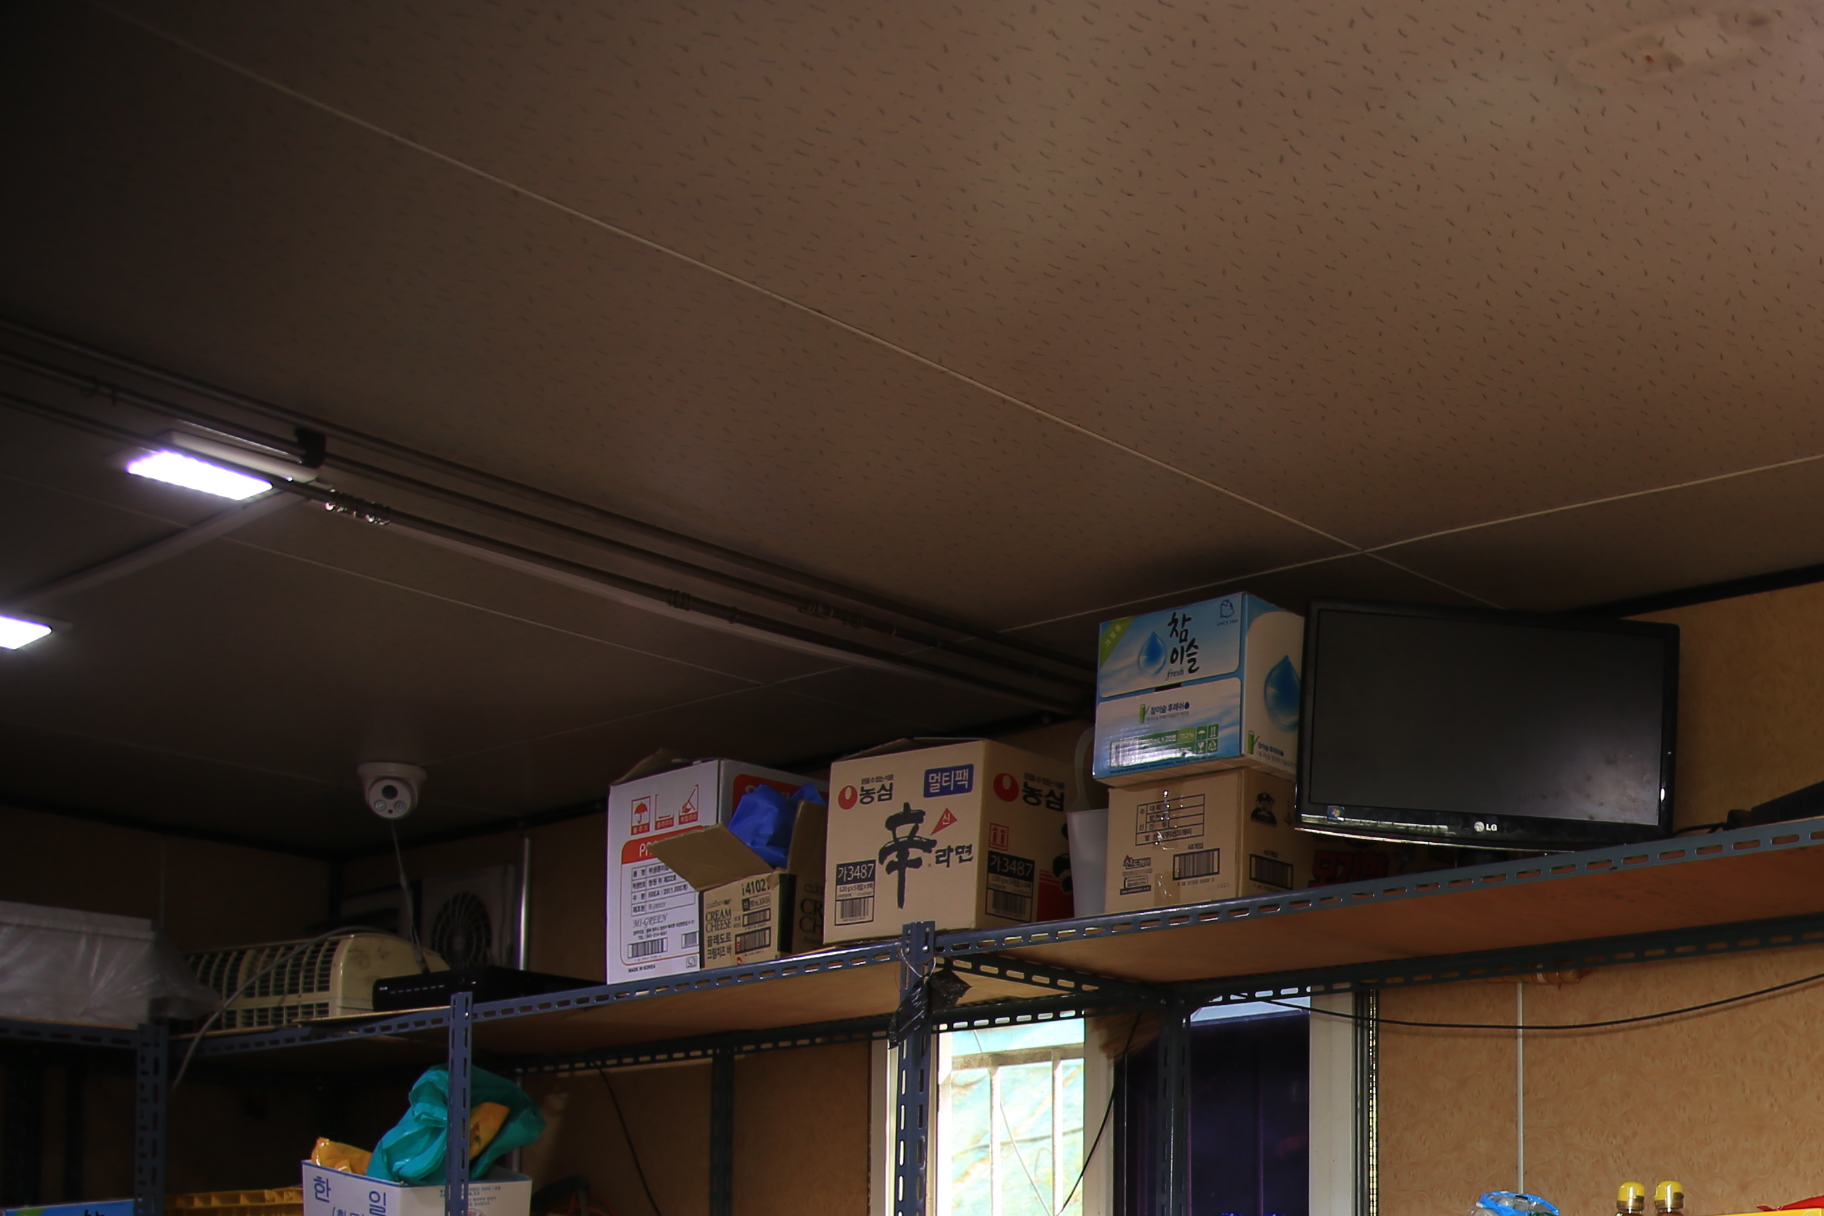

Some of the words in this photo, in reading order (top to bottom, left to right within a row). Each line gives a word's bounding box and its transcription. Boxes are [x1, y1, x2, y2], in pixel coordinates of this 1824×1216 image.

[1167, 611, 1192, 643] 참
[1170, 638, 1200, 674] 이슬
[928, 769, 969, 793] 멀티팩
[859, 783, 894, 805] 농심
[1022, 783, 1065, 812] 농심
[1486, 823, 1497, 831] LG
[879, 802, 937, 909] 辛
[935, 844, 973, 868] 라면
[989, 856, 1033, 877] 가3487
[837, 864, 874, 882] 가3487
[705, 909, 732, 922] CREAM
[705, 919, 732, 933] CHEESE
[314, 1176, 331, 1203] 한
